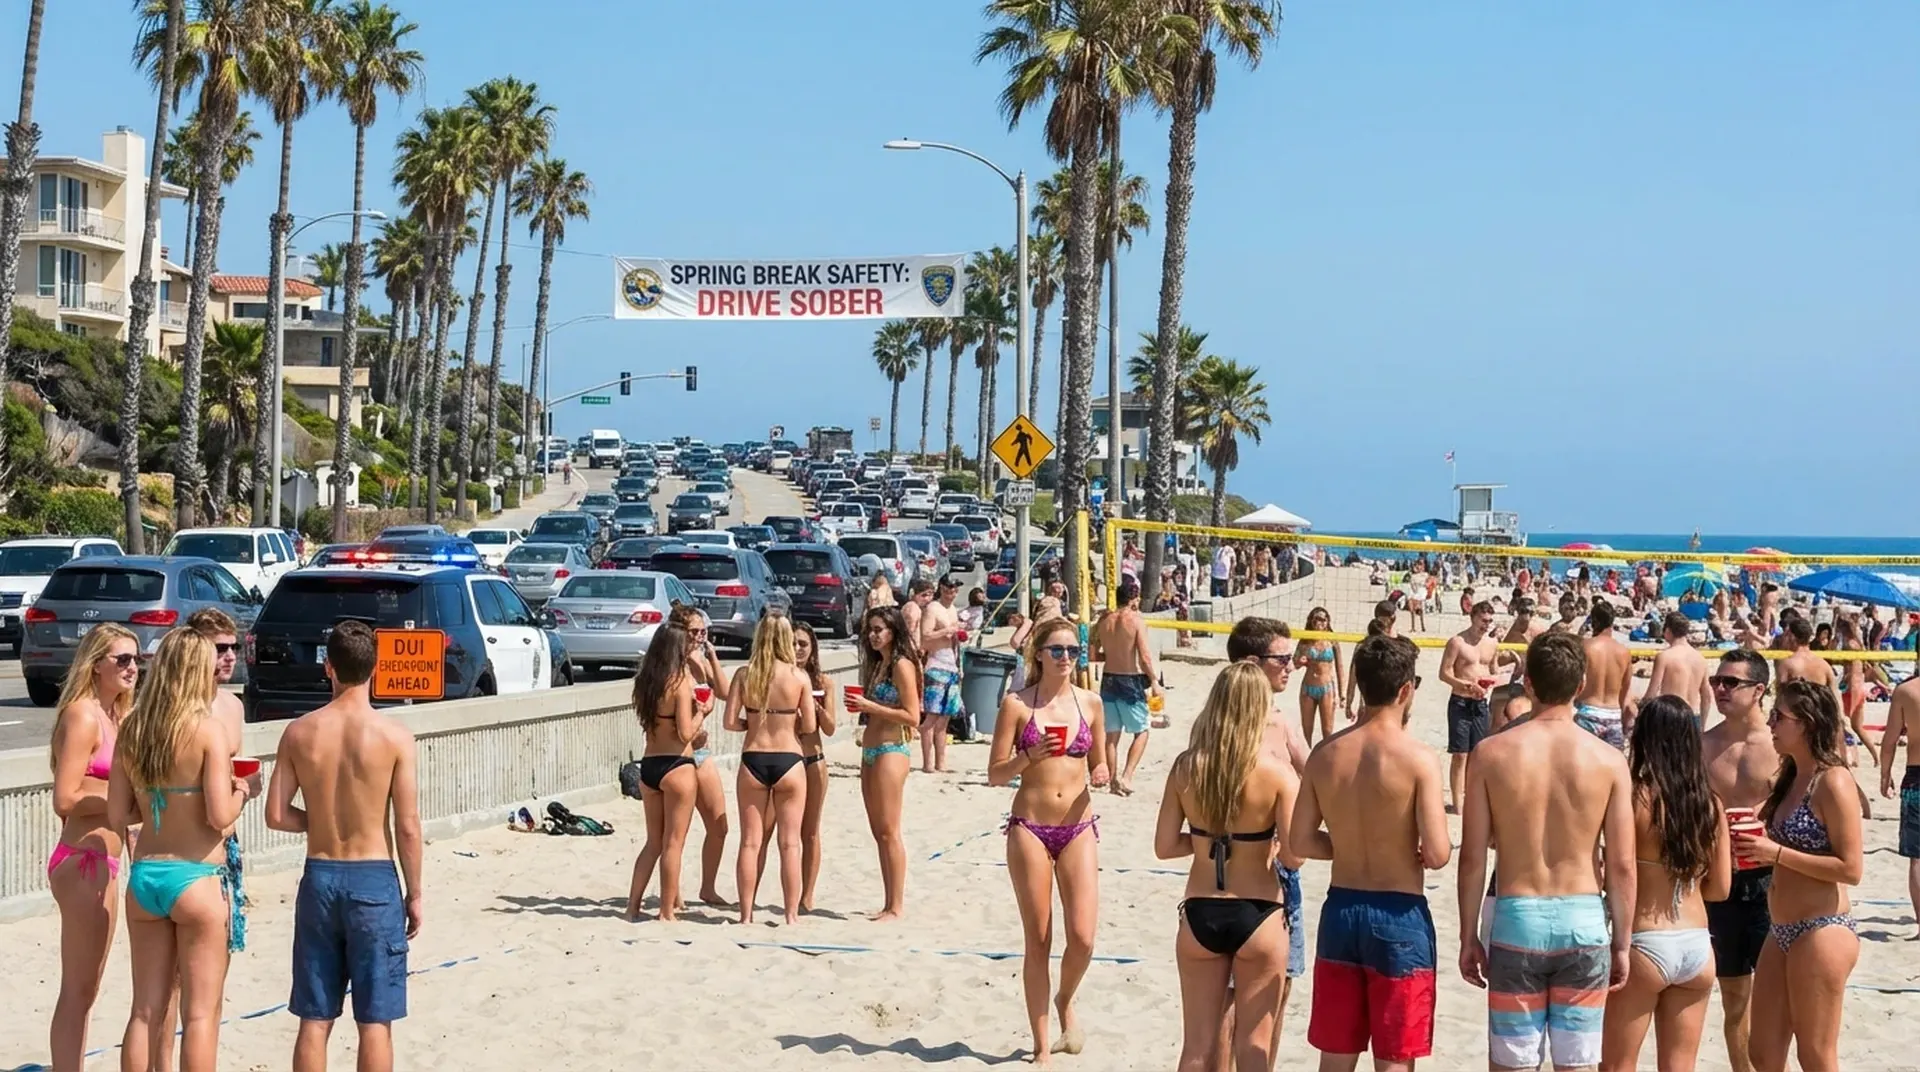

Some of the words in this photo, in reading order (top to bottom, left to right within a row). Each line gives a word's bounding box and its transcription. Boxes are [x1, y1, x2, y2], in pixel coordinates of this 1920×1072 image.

[670, 264, 746, 286] SPRING
[753, 264, 821, 285] BREAK
[827, 263, 910, 284] SAFETY:
[697, 289, 781, 316] DRIVE
[790, 288, 884, 316] SOBER
[394, 638, 424, 656] DUI
[386, 677, 431, 691] AHEAD
